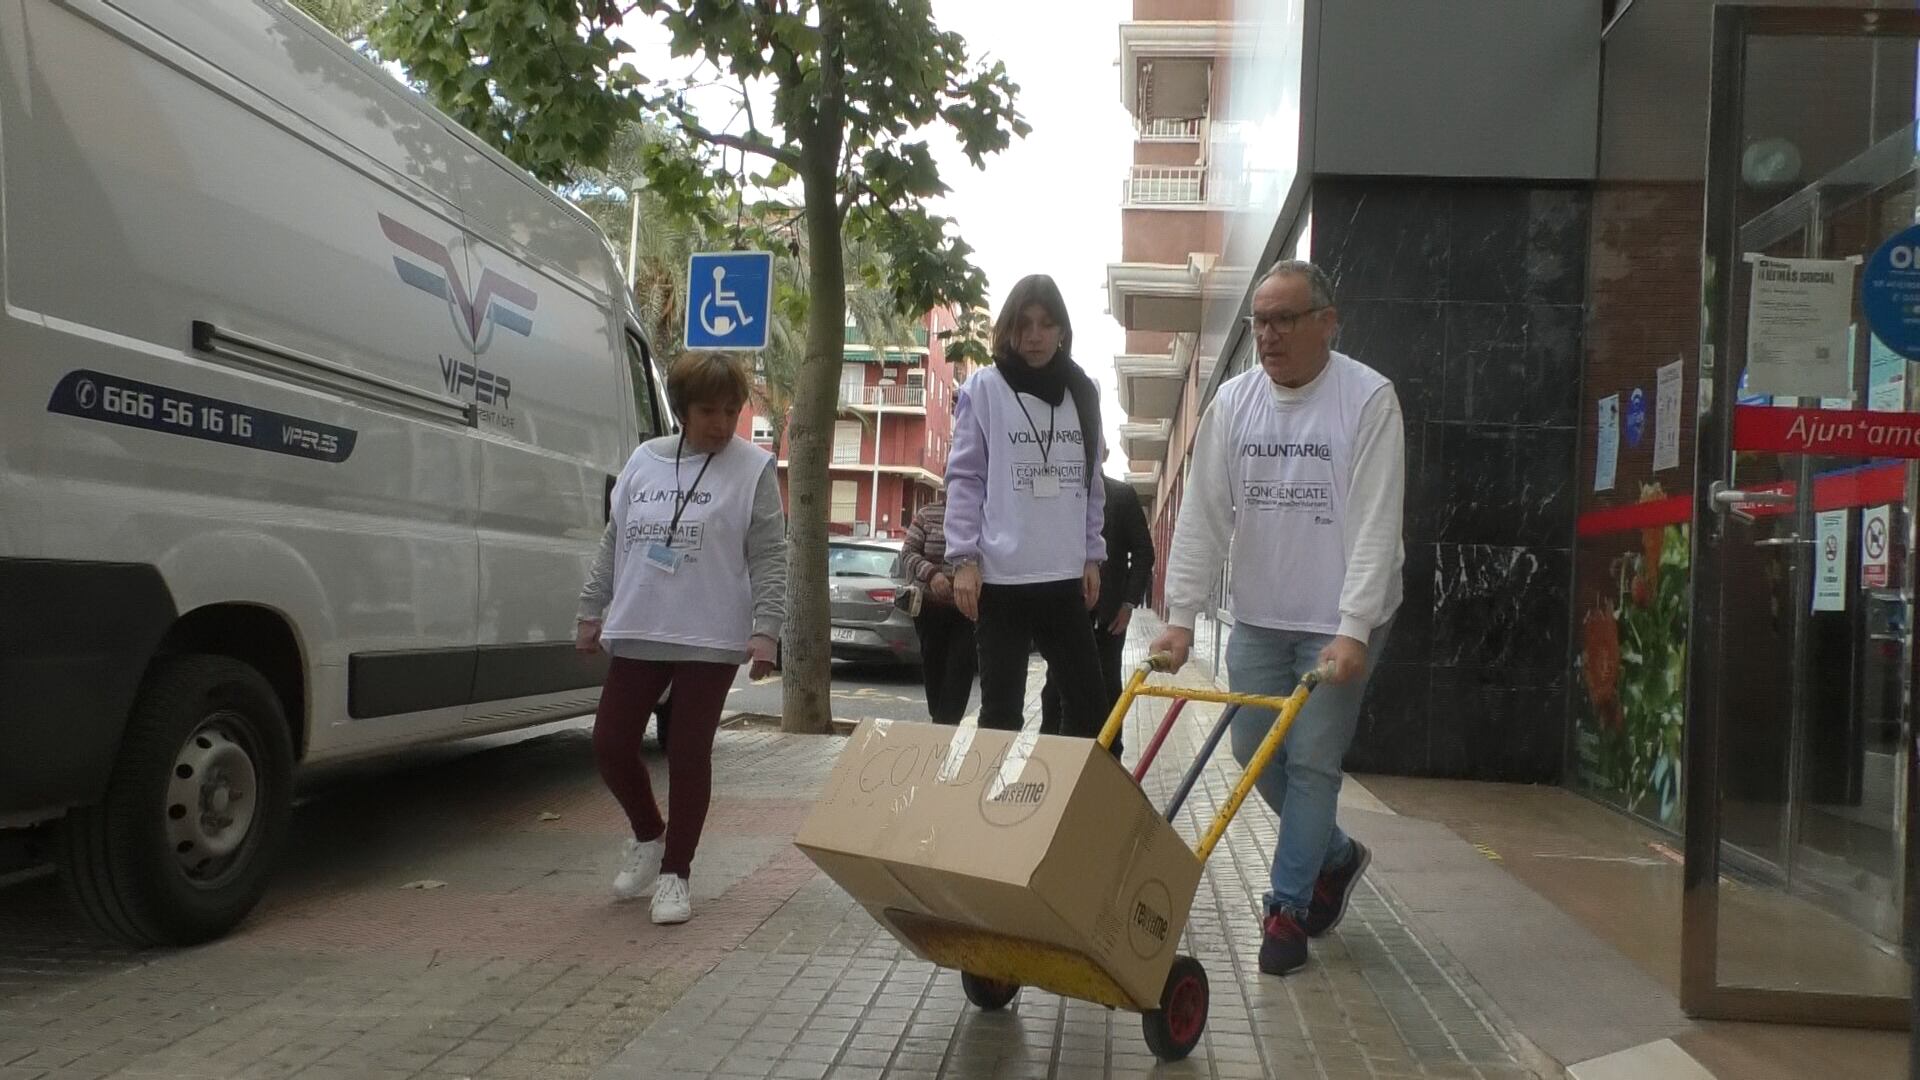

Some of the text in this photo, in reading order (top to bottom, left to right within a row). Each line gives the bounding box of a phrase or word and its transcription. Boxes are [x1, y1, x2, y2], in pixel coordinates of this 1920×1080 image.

[438, 353, 511, 411] VIPER
[103, 385, 154, 419] 666
[162, 398, 193, 427] 56
[201, 407, 223, 433] 16
[231, 413, 252, 438] 16
